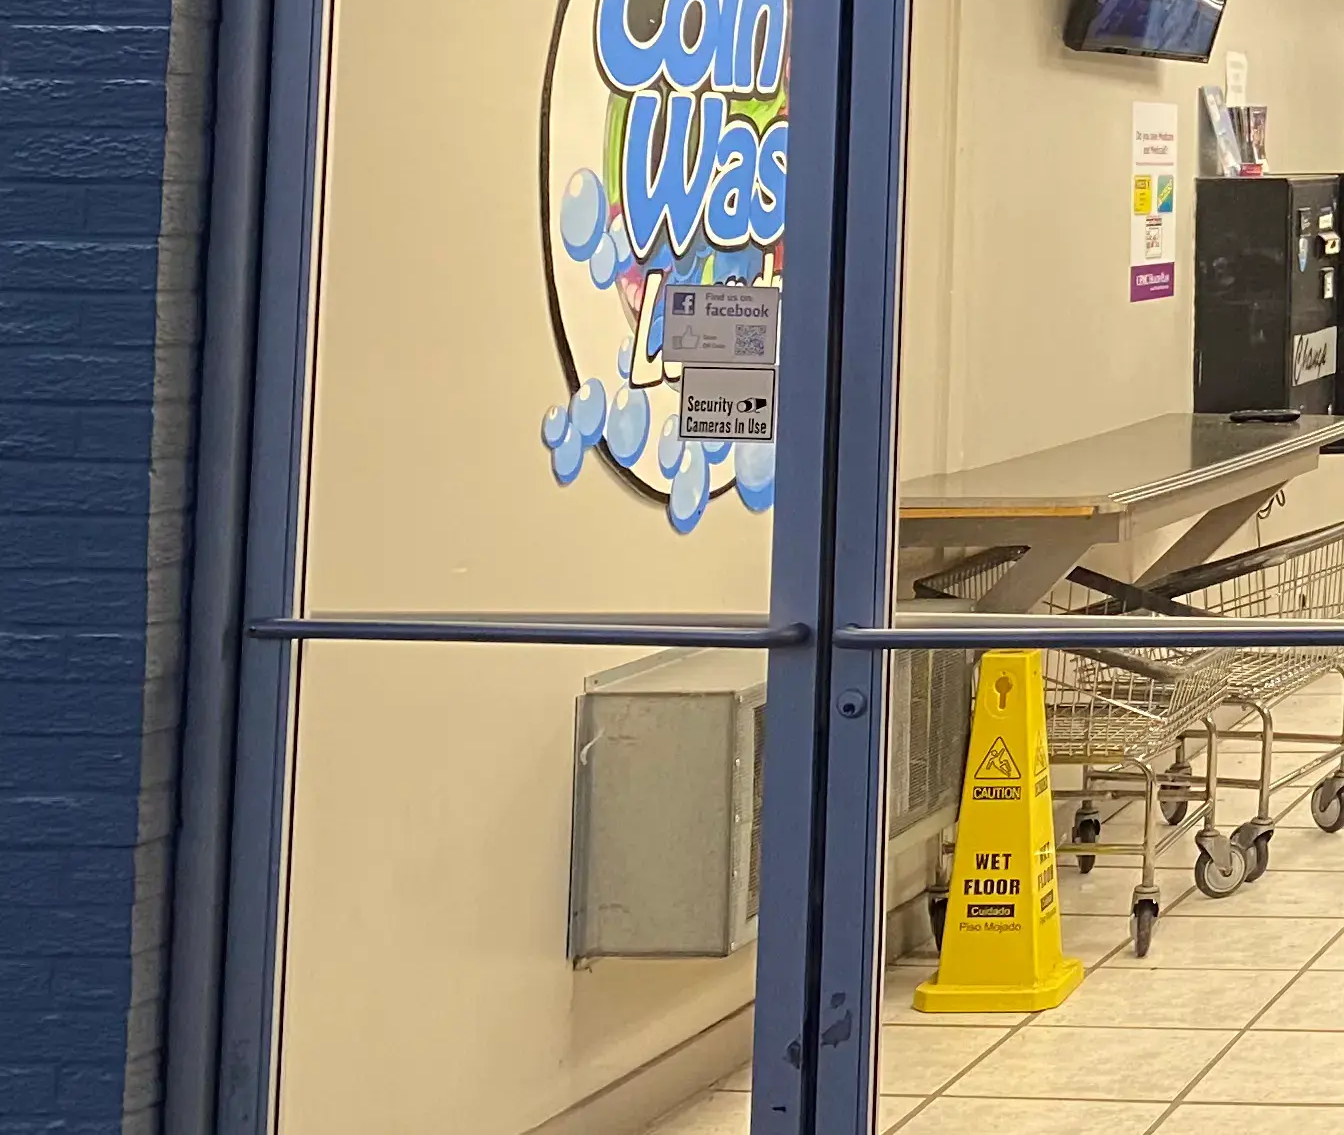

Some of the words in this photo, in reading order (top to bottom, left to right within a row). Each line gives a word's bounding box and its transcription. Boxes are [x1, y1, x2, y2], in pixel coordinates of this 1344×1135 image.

[705, 292, 725, 302] Find
[727, 294, 738, 302] us
[705, 302, 769, 317] facebook
[687, 395, 734, 416] Security
[686, 416, 731, 433] Cameras
[734, 417, 745, 434] In
[749, 418, 767, 435] Use
[973, 786, 1021, 800] CAUTION
[975, 852, 1013, 871] WET
[963, 878, 1021, 895] FLOOR
[970, 906, 1011, 916] Cuidado
[959, 922, 982, 932] Piso
[984, 921, 1022, 934] Mojado
